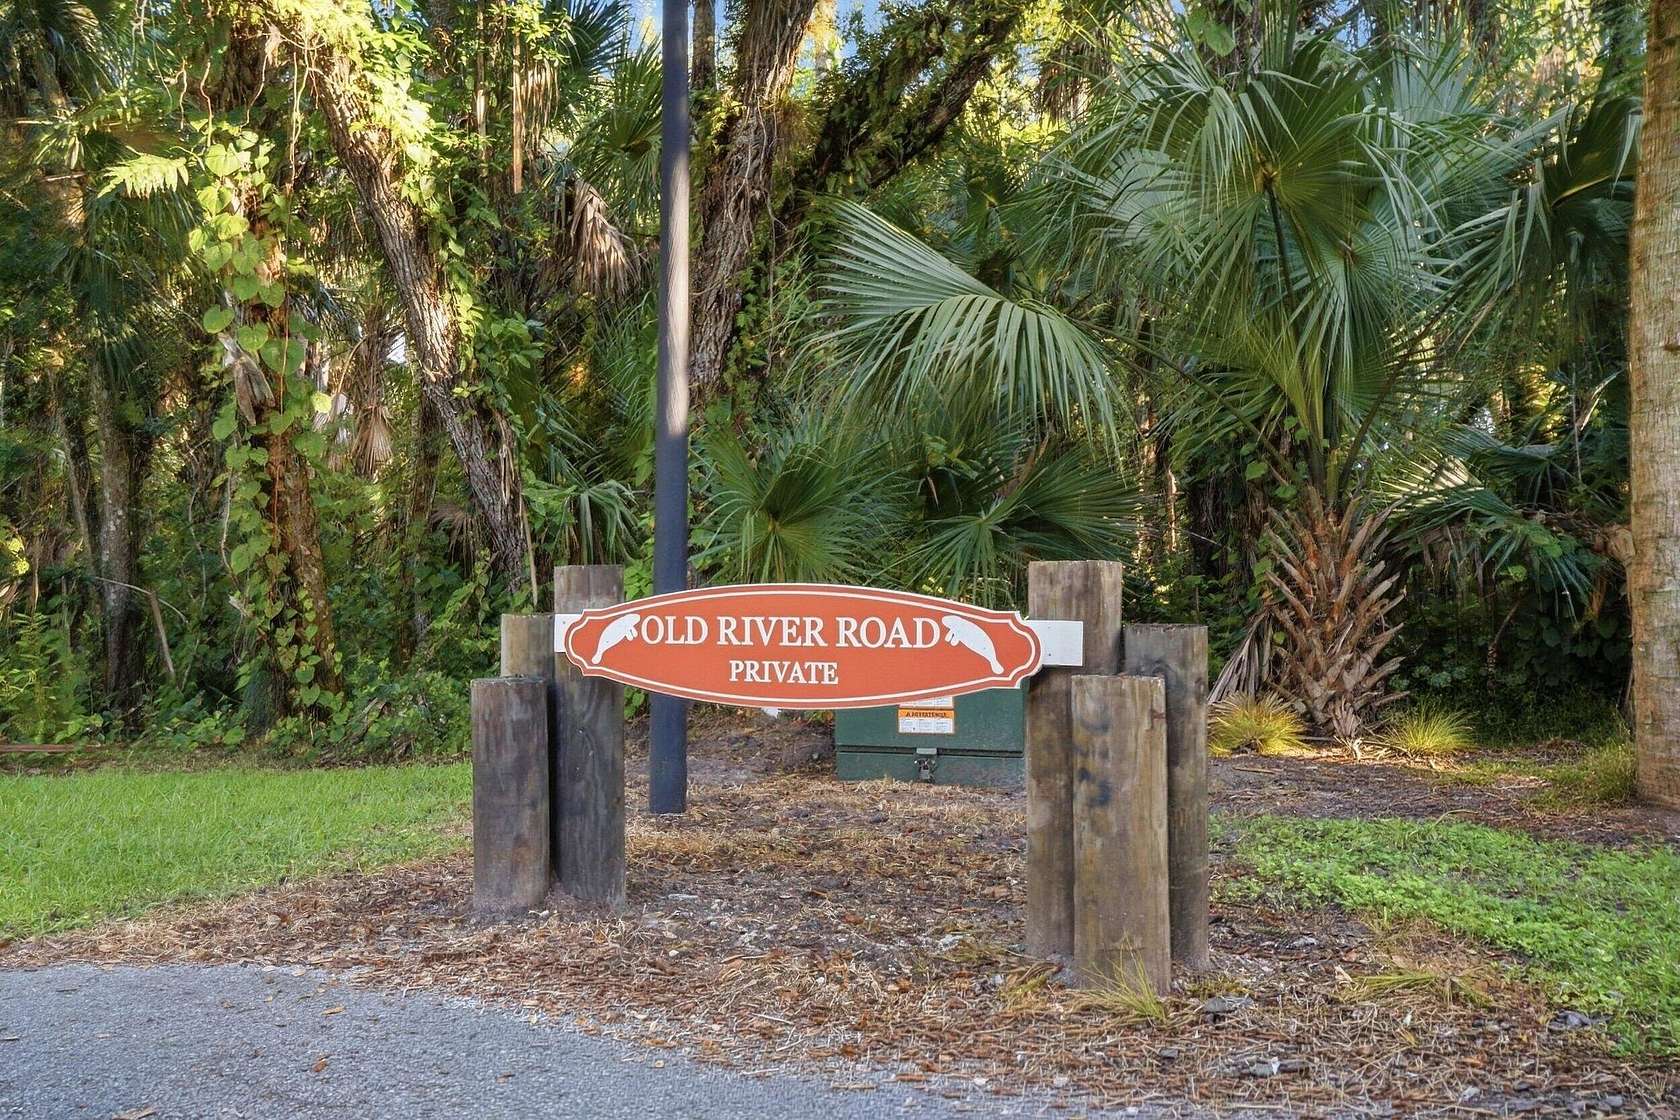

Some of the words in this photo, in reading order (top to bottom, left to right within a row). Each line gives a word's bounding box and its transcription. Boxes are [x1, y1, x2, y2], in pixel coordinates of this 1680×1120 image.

[640, 614, 709, 645] OLD
[716, 615, 828, 647] RIVER
[835, 616, 941, 649] ROAD
[728, 659, 839, 685] PRIVATE
